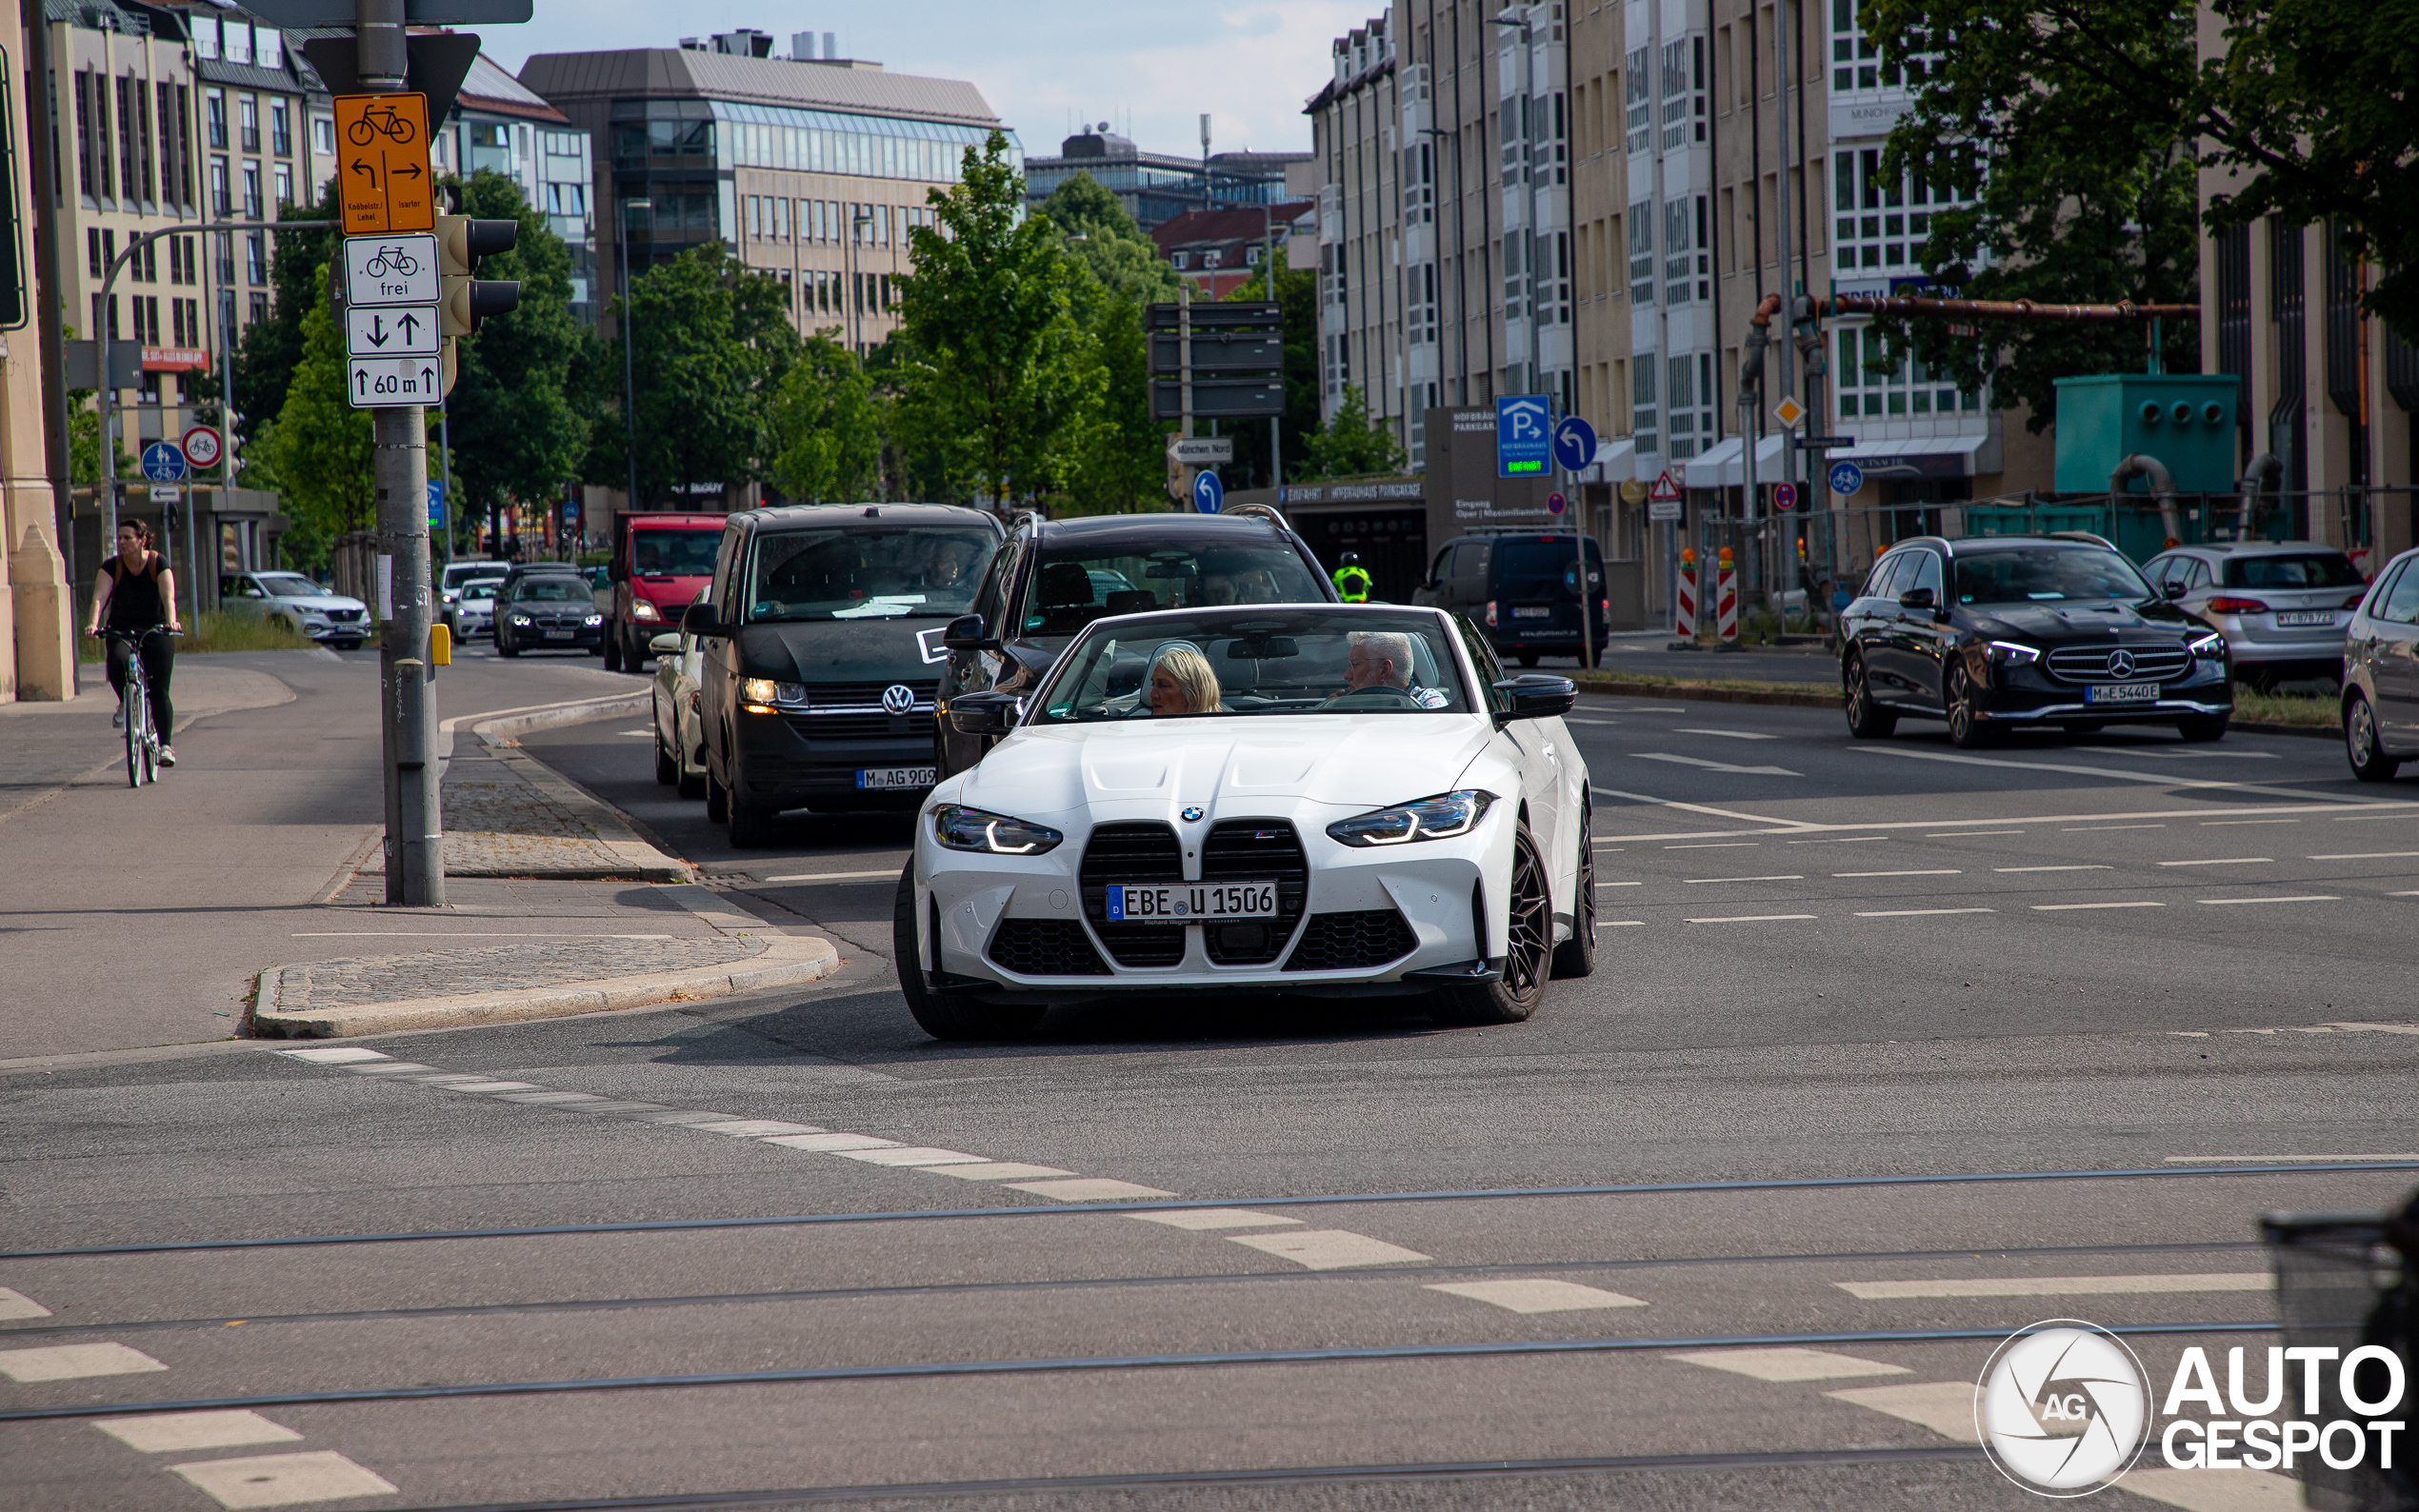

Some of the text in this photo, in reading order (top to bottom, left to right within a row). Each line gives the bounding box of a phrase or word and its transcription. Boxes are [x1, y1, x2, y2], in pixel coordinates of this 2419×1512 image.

[348, 201, 383, 210] Knöbelstr./
[398, 200, 421, 209] Isartor
[357, 212, 376, 222] Lehel
[380, 280, 409, 296] frei
[373, 374, 417, 394] 60 m
[1512, 411, 1532, 439] P
[1288, 487, 1323, 502] EINFAHRT
[1455, 494, 1491, 509] Eingang
[1455, 508, 1478, 519] Oper
[2092, 686, 2102, 700] M
[2109, 686, 2118, 700] E
[866, 770, 876, 786] M
[886, 769, 906, 786] AG
[1112, 885, 1273, 916] D EBE U 1506
